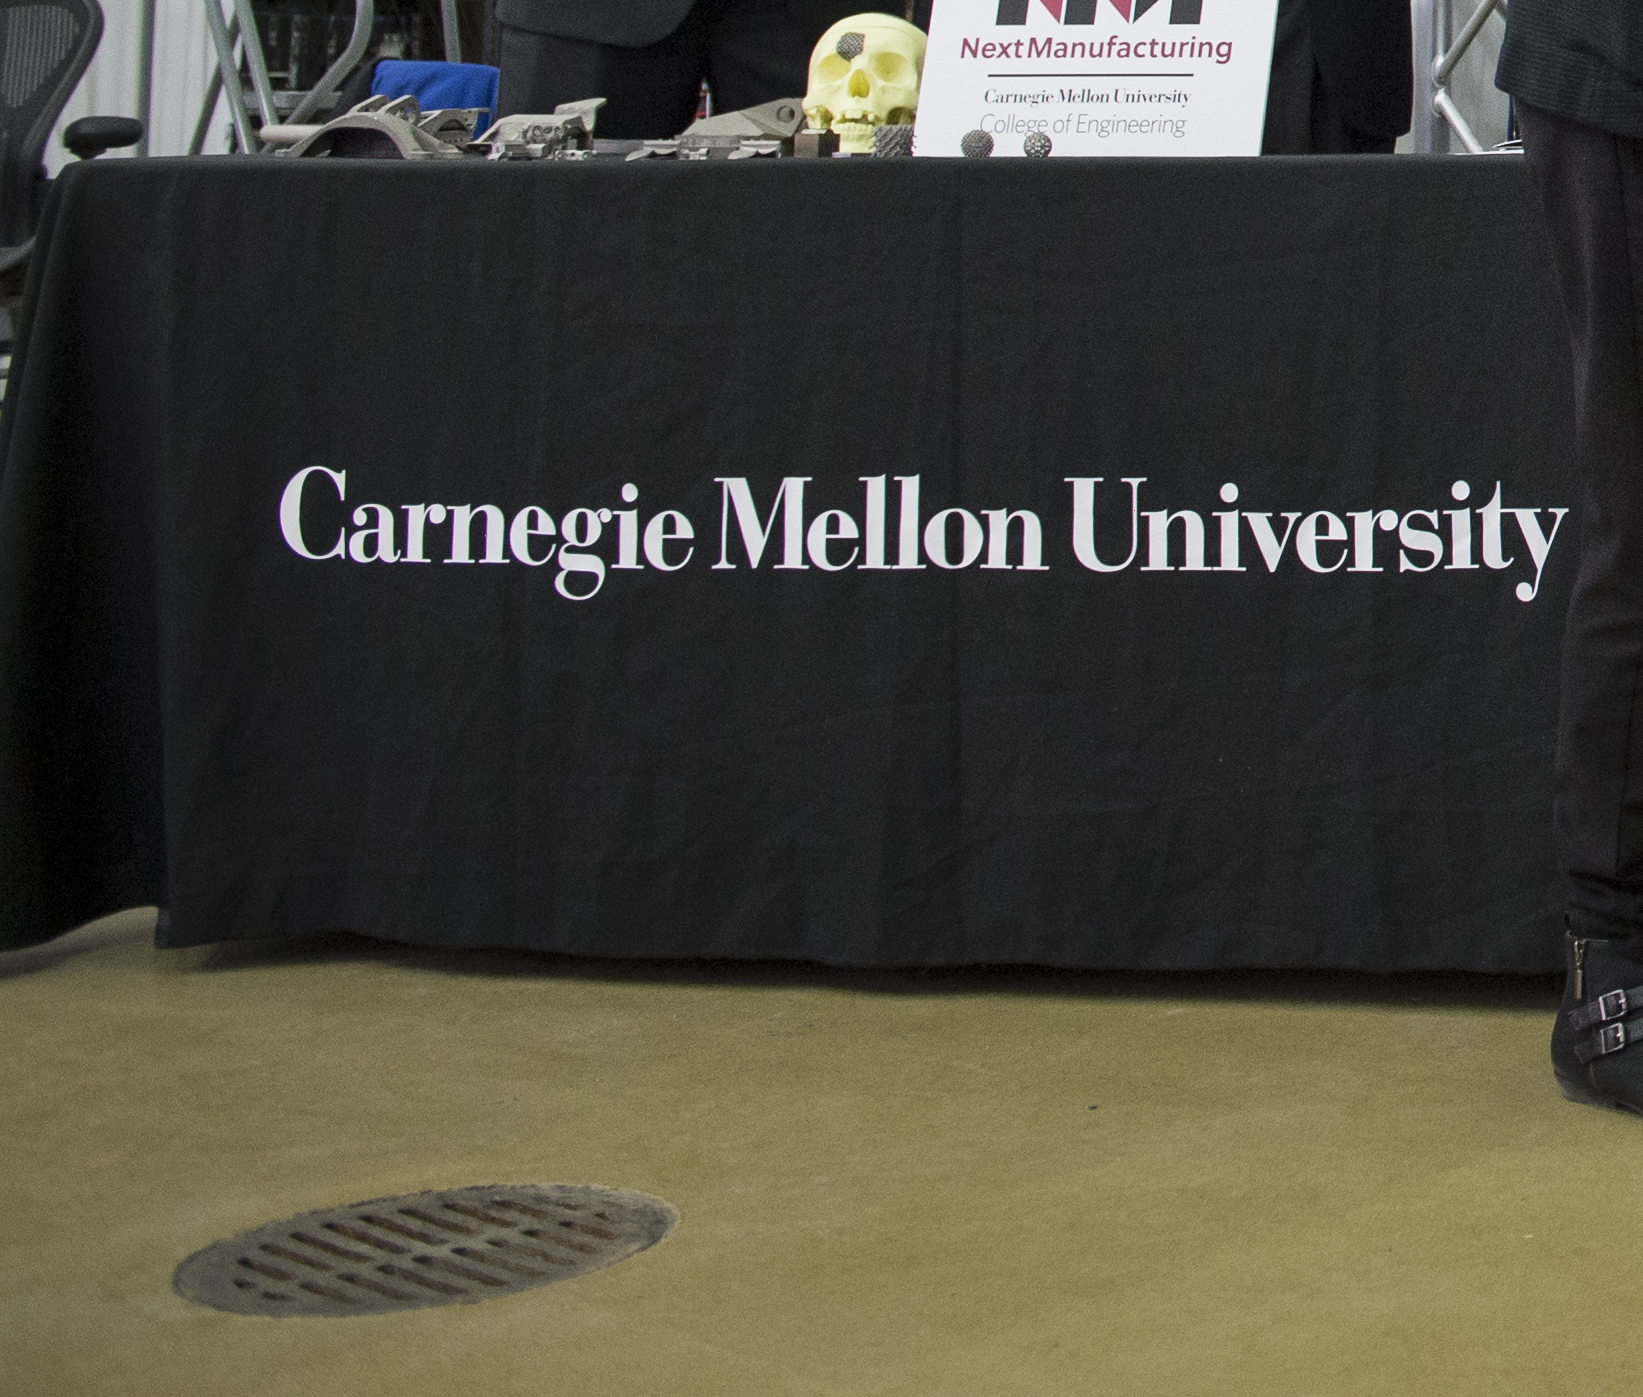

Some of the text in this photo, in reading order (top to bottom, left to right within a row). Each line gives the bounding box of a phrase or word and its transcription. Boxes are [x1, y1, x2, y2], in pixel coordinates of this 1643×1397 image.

[984, 88, 1192, 108] Carnegie Mellon University
[979, 113, 1187, 139] College of Engineering
[278, 465, 1570, 603] Carnegie Mellon University
